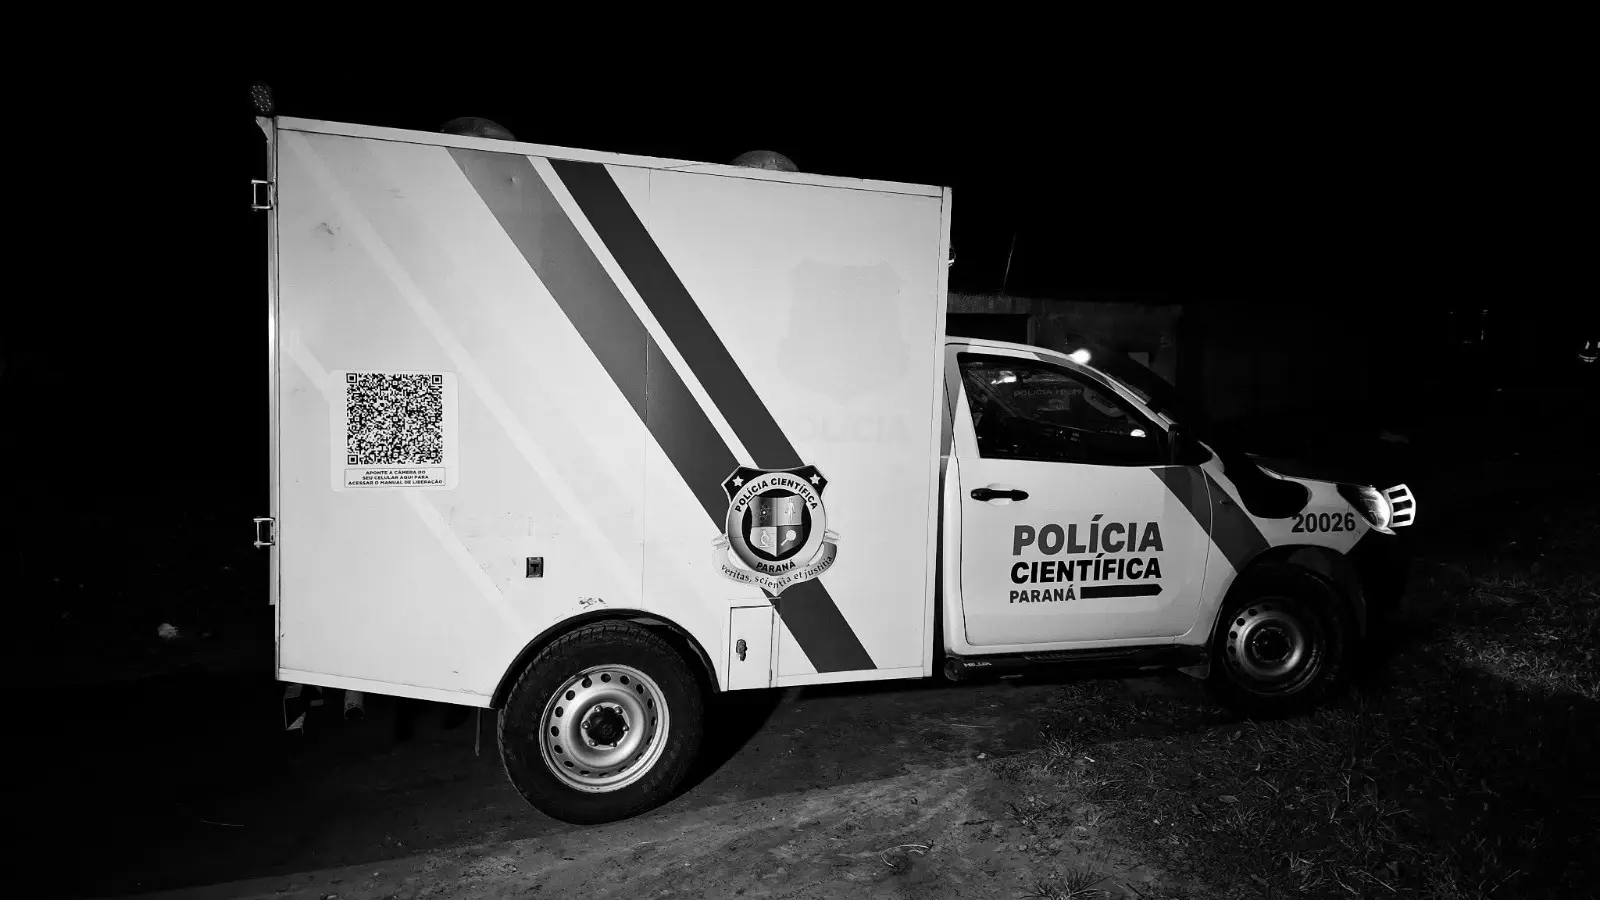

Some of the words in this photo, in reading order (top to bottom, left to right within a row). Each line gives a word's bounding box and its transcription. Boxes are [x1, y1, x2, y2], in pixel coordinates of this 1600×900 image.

[734, 480, 769, 512] POLÍCIA
[770, 477, 818, 510] CIENTÍFICA
[1012, 514, 1163, 556] POLÍCIA
[1291, 512, 1356, 533] 20026
[721, 564, 752, 582] veritas,
[754, 575, 792, 589] scientia
[793, 571, 803, 580] et
[804, 555, 833, 579] justitia
[756, 559, 796, 573] PARANÁ
[1010, 553, 1162, 584] CIENTÍFICA
[1009, 584, 1076, 603] PARANÁ
